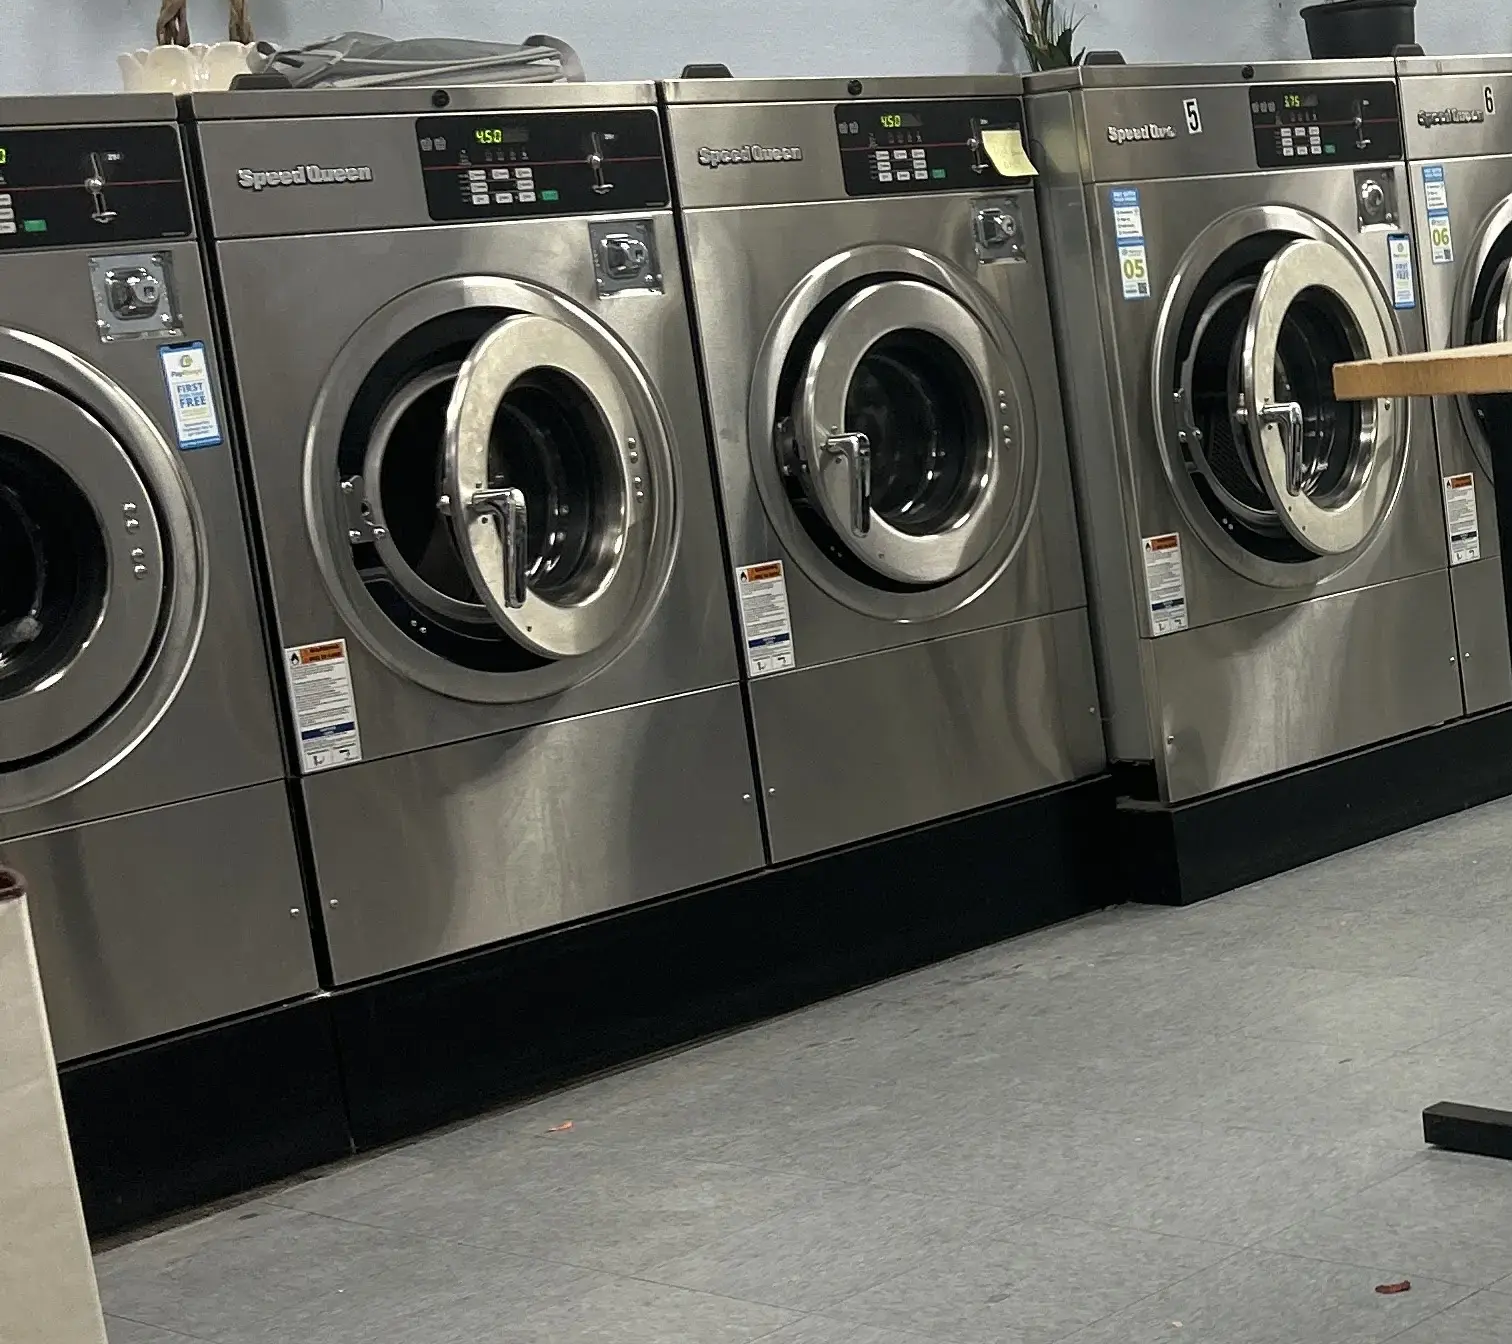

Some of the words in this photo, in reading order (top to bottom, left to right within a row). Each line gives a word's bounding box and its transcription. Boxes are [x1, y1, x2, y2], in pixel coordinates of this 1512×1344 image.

[1484, 87, 1493, 113] 6
[1186, 101, 1199, 131] 5
[1107, 123, 1150, 144] Speed
[698, 145, 751, 169] Speed
[750, 144, 803, 161] Queen
[237, 165, 306, 191] Speed
[305, 164, 374, 183] Queen
[1432, 227, 1450, 246] 06
[1123, 258, 1145, 279] 05
[177, 382, 203, 394] FIRST
[180, 395, 207, 409] FREE
